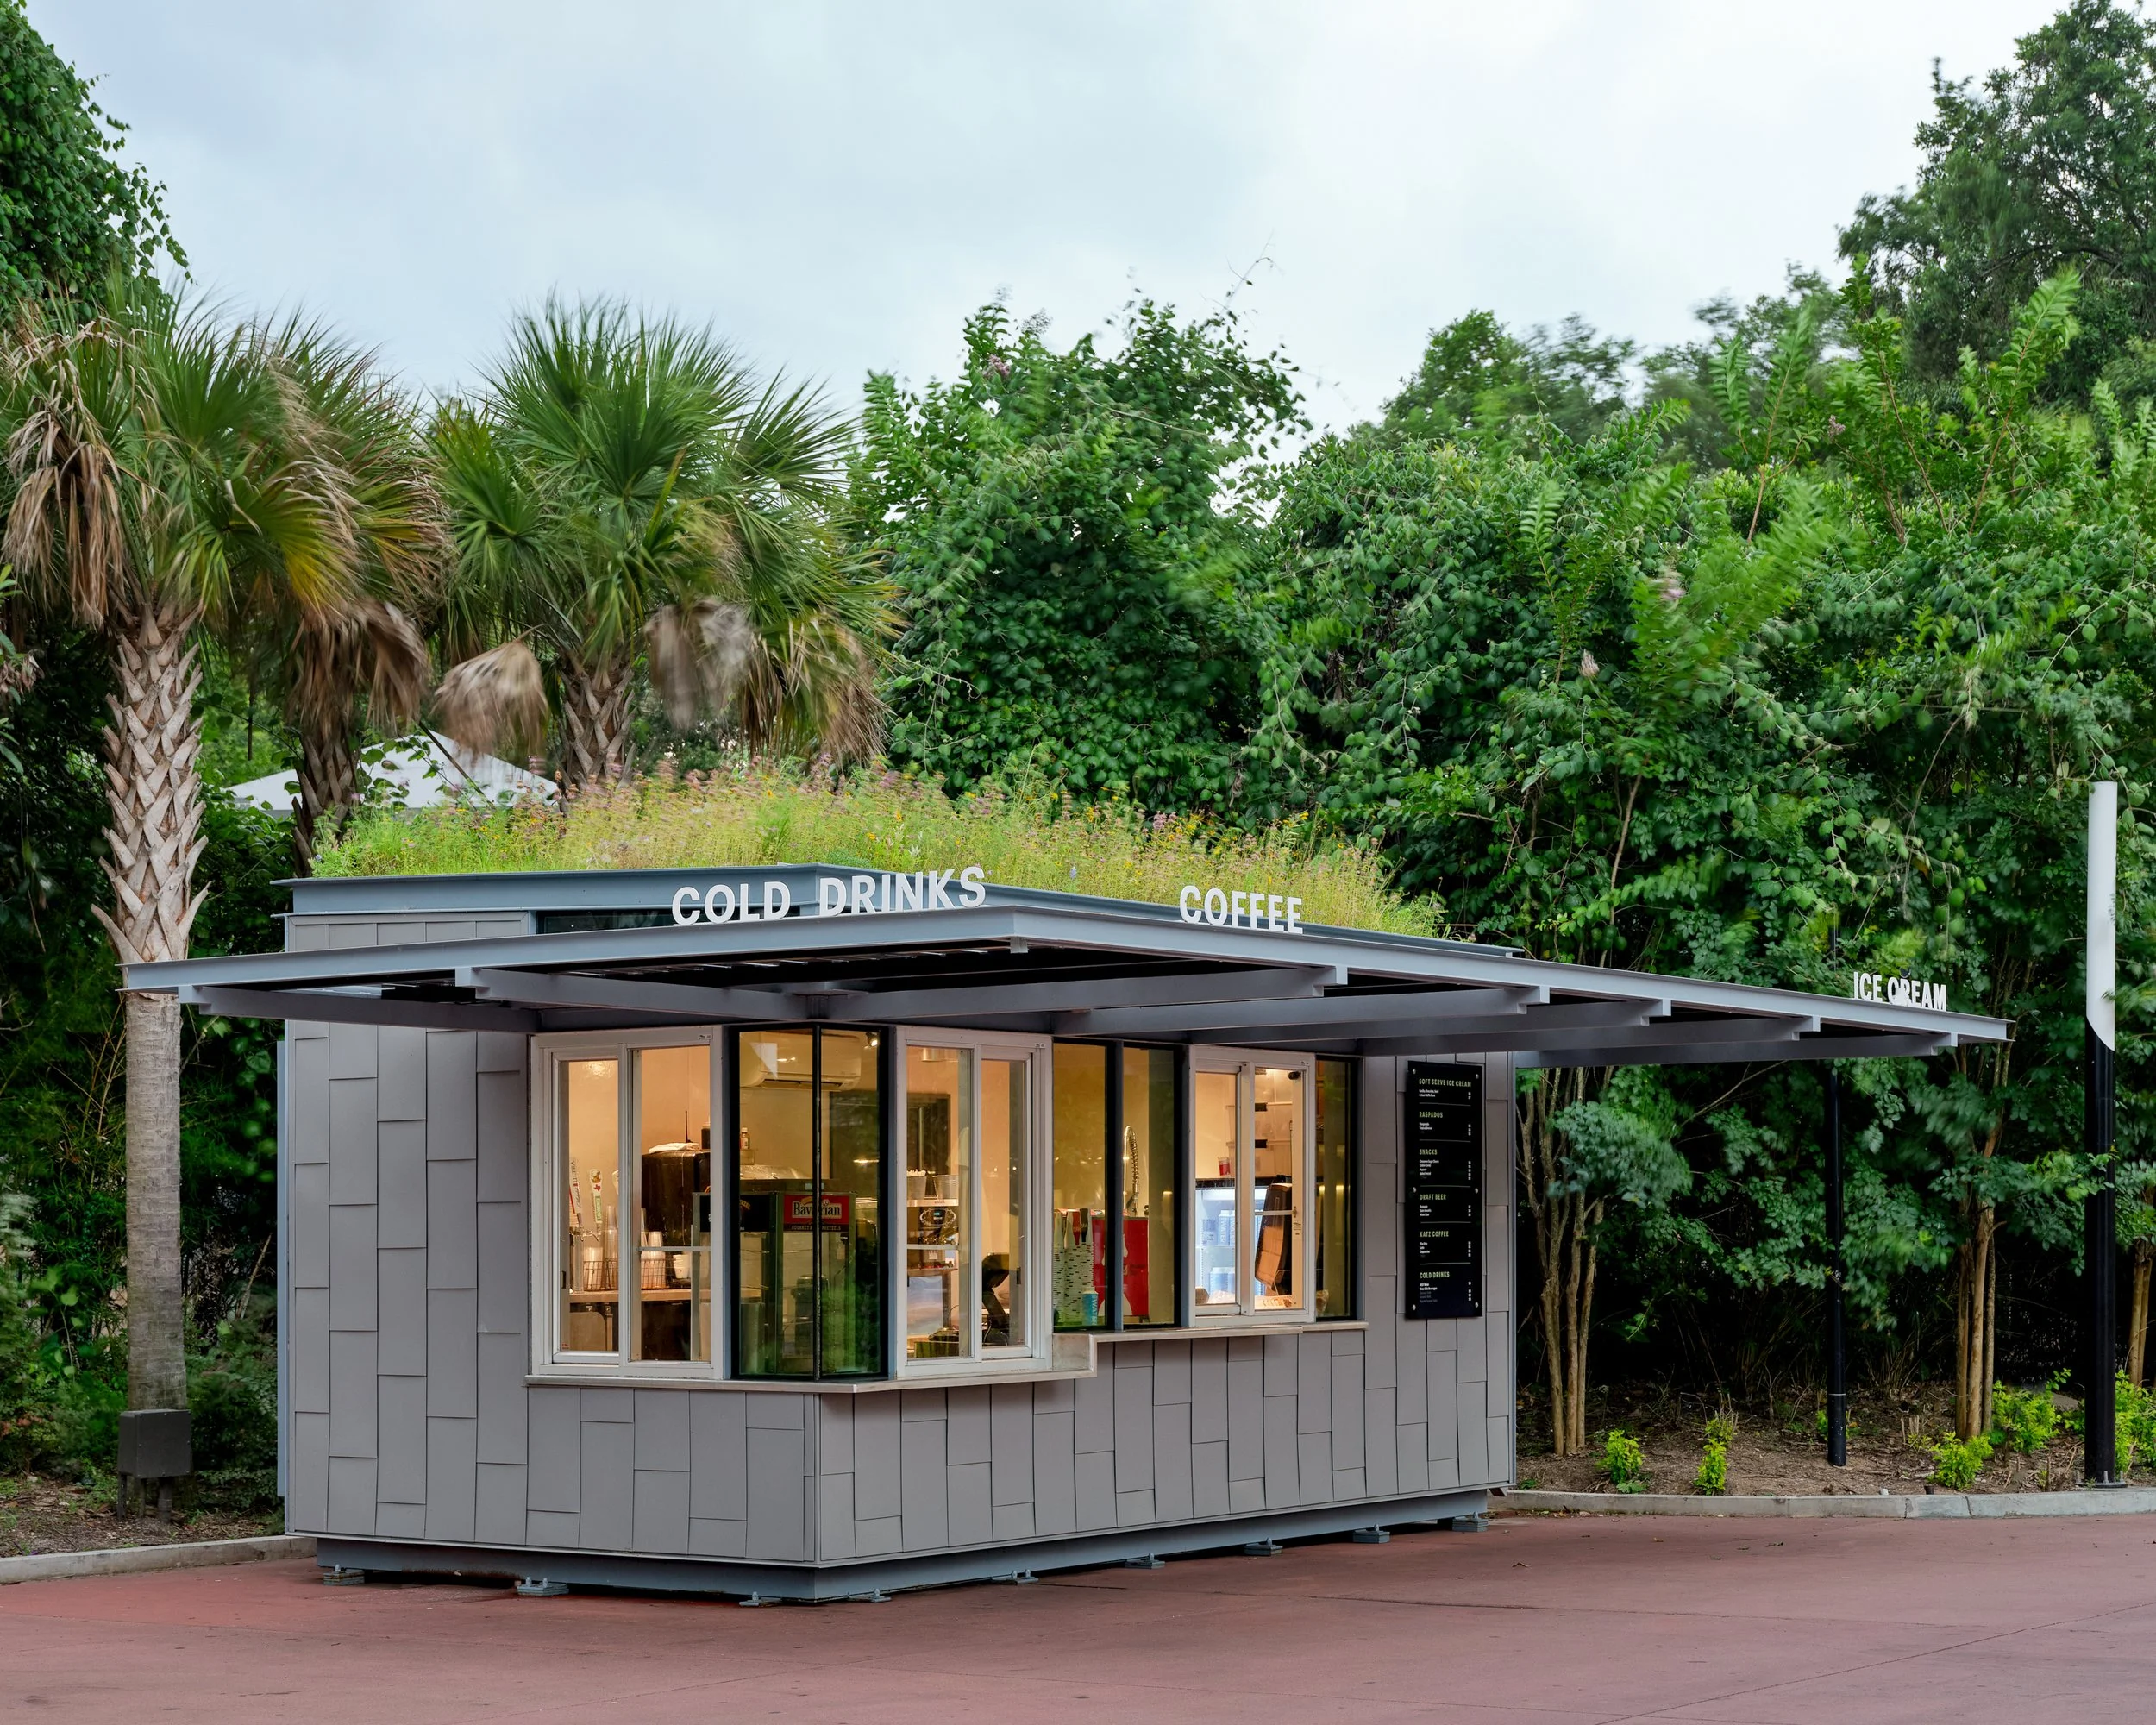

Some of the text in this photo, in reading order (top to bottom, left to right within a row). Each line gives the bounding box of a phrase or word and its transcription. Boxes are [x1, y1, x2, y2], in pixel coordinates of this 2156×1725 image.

[672, 867, 986, 925] COLD DRINKS
[1180, 885, 1303, 934] COFFEE
[1853, 972, 1946, 1012] ICE CREAM
[793, 1202, 840, 1215] Bavian
